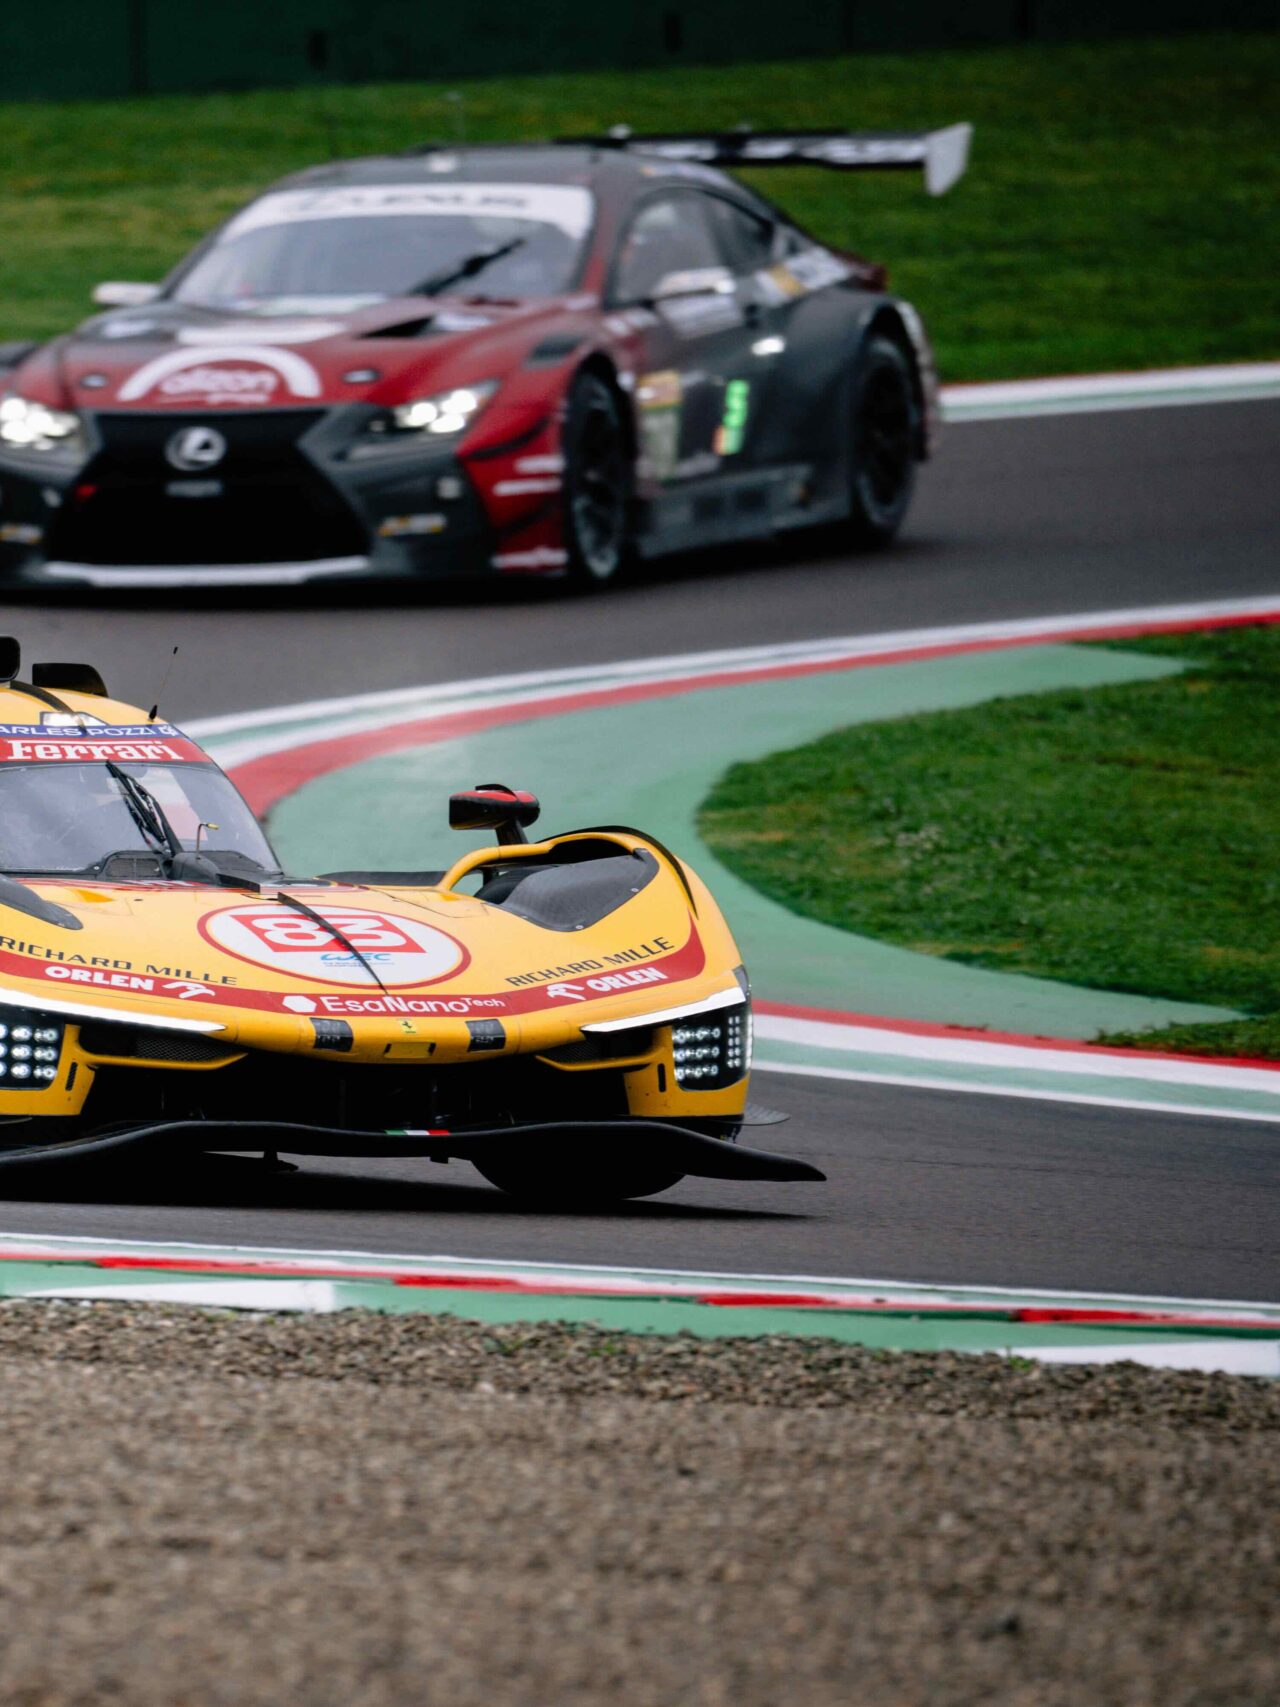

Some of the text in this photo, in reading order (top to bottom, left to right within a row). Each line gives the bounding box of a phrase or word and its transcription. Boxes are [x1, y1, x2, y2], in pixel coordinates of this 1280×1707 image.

[86, 724, 157, 736] POZZI
[6, 739, 184, 761] Ferrari
[251, 916, 408, 948] 83
[505, 936, 675, 986] RICHARD MILLE
[44, 966, 154, 992] ORLEN
[146, 964, 237, 986] MILLE
[586, 967, 669, 992] ORLEN
